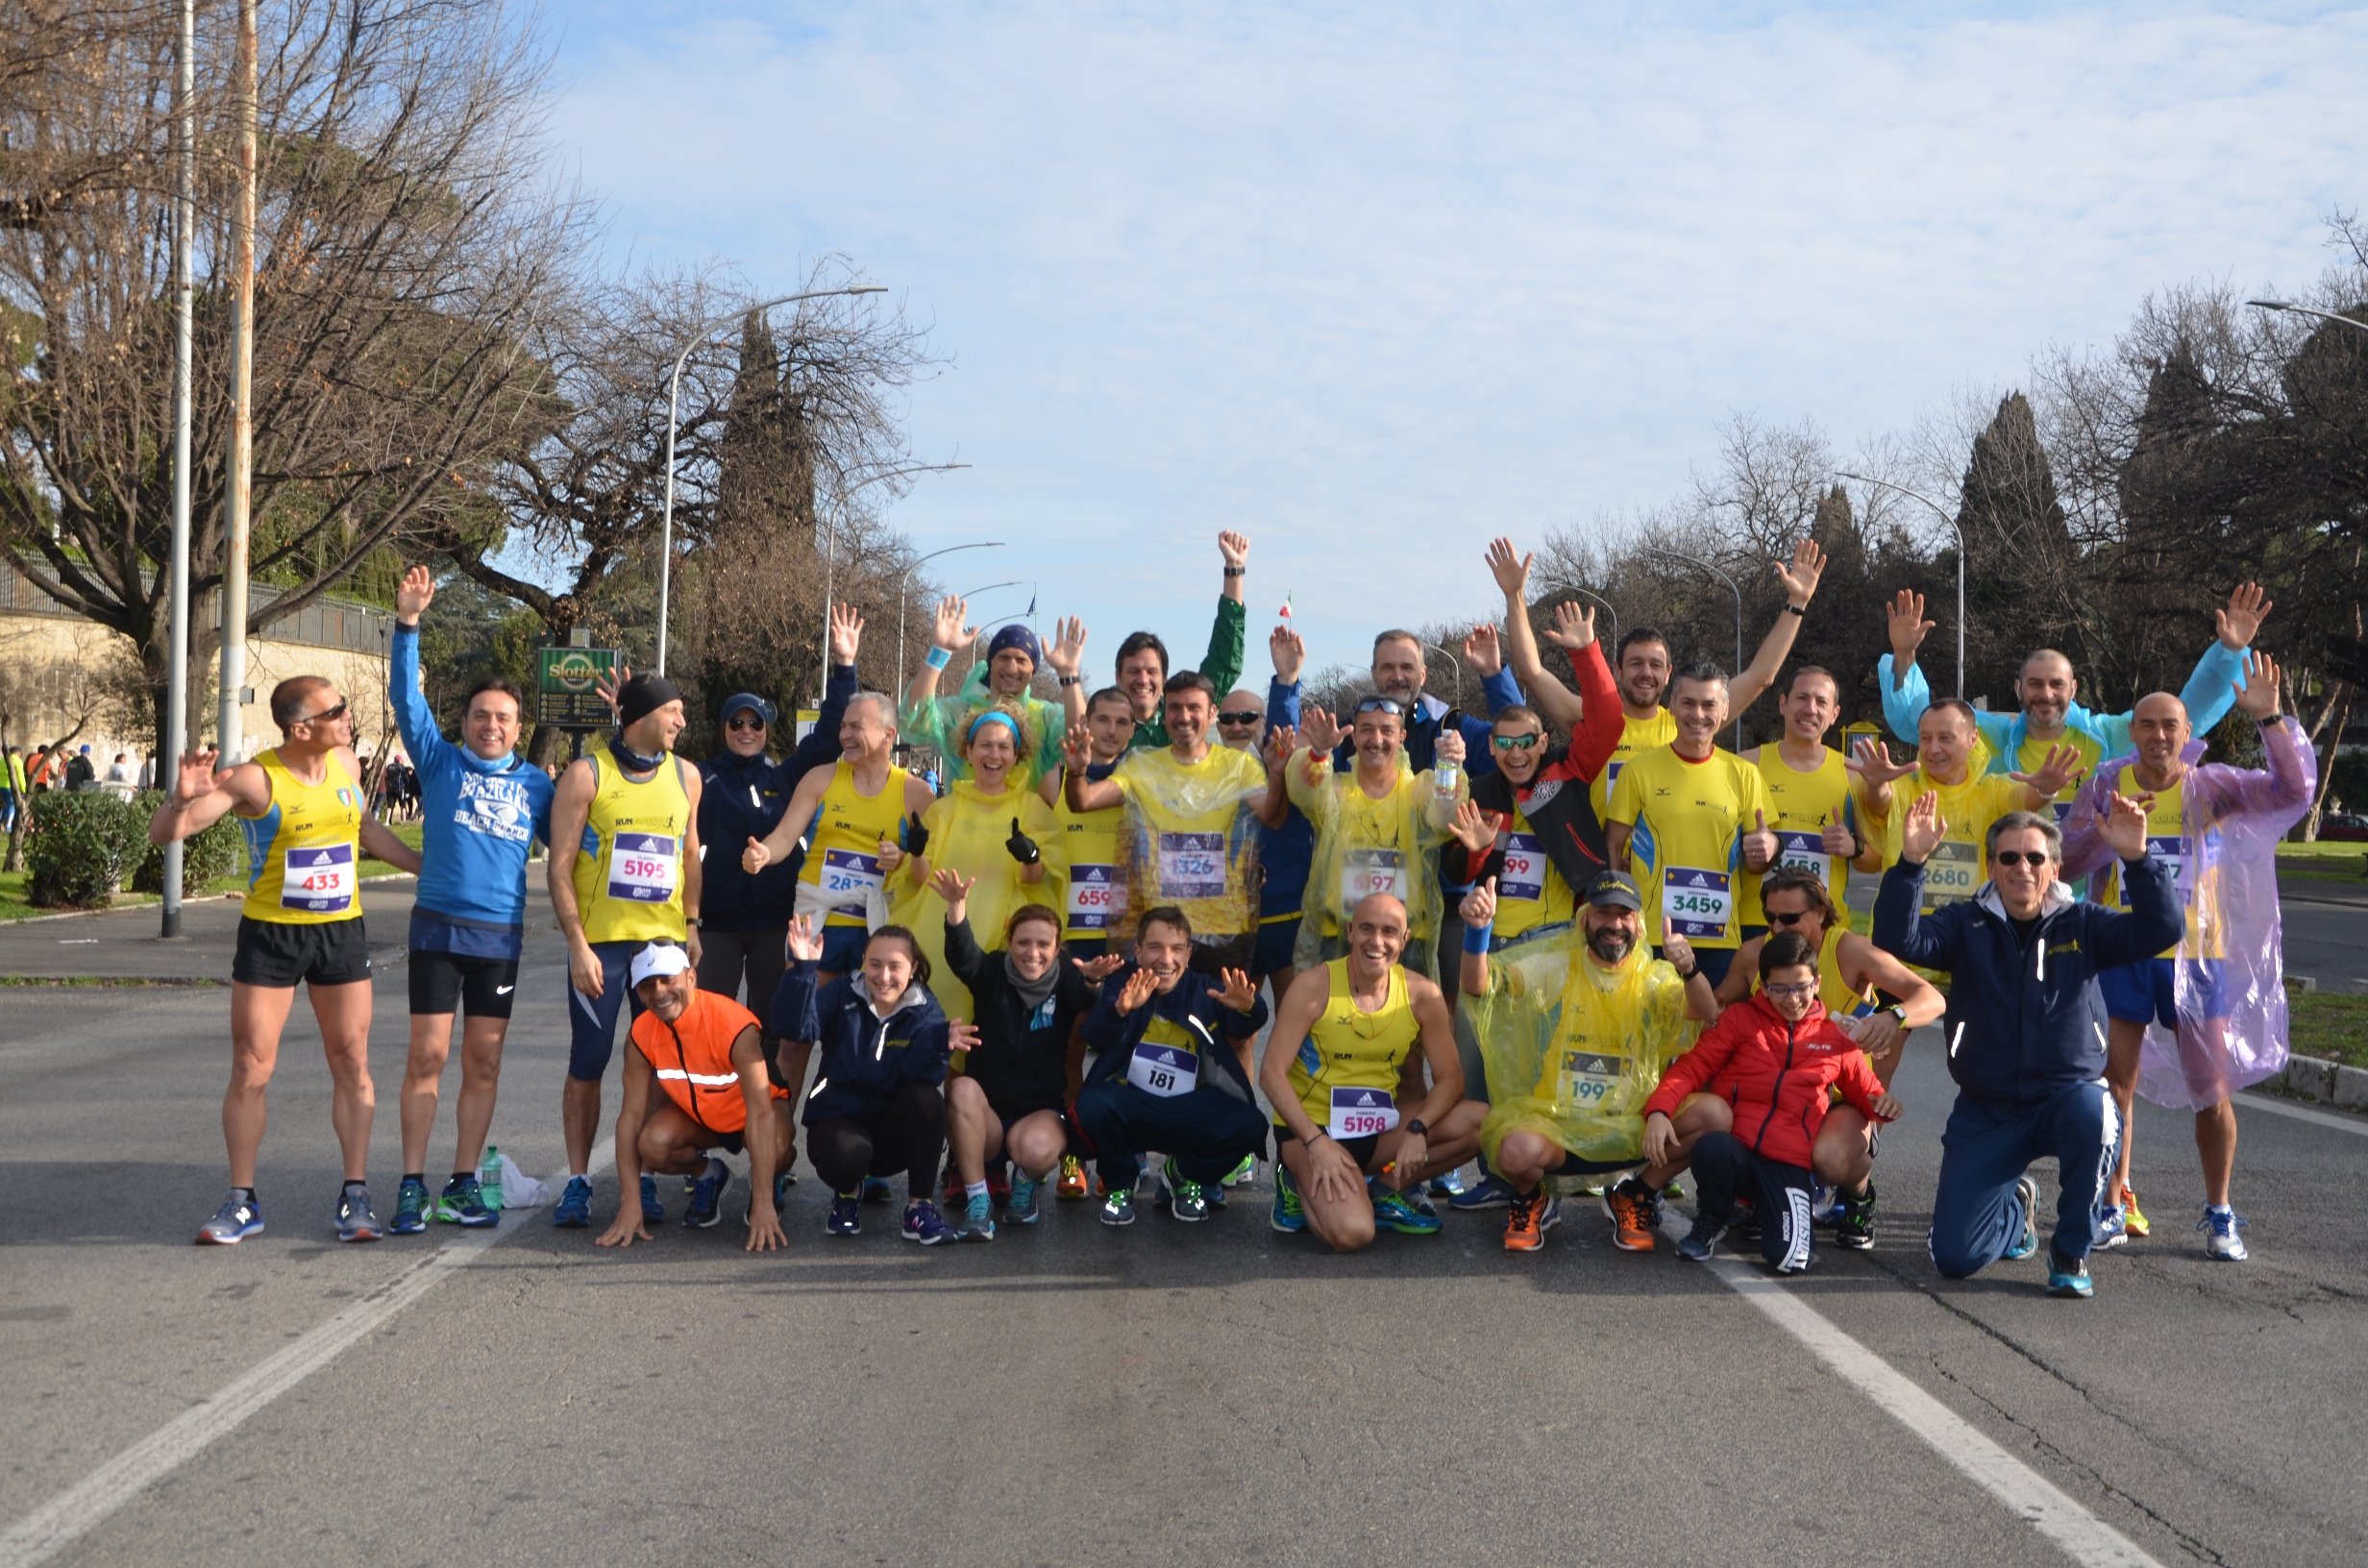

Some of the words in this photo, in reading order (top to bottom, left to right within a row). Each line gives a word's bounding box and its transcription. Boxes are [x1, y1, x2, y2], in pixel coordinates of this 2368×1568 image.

[454, 809, 492, 830] BEACH
[492, 819, 530, 843] SOCCER
[624, 859, 665, 879] 5195
[1171, 859, 1214, 874] 1326
[1501, 858, 1530, 874] 99
[301, 873, 340, 891] 433
[1923, 868, 1970, 887] 2680
[1077, 890, 1112, 906] 659
[1672, 894, 1723, 915] 3459
[1148, 1069, 1175, 1091] 181
[1344, 1116, 1386, 1134] 5198
